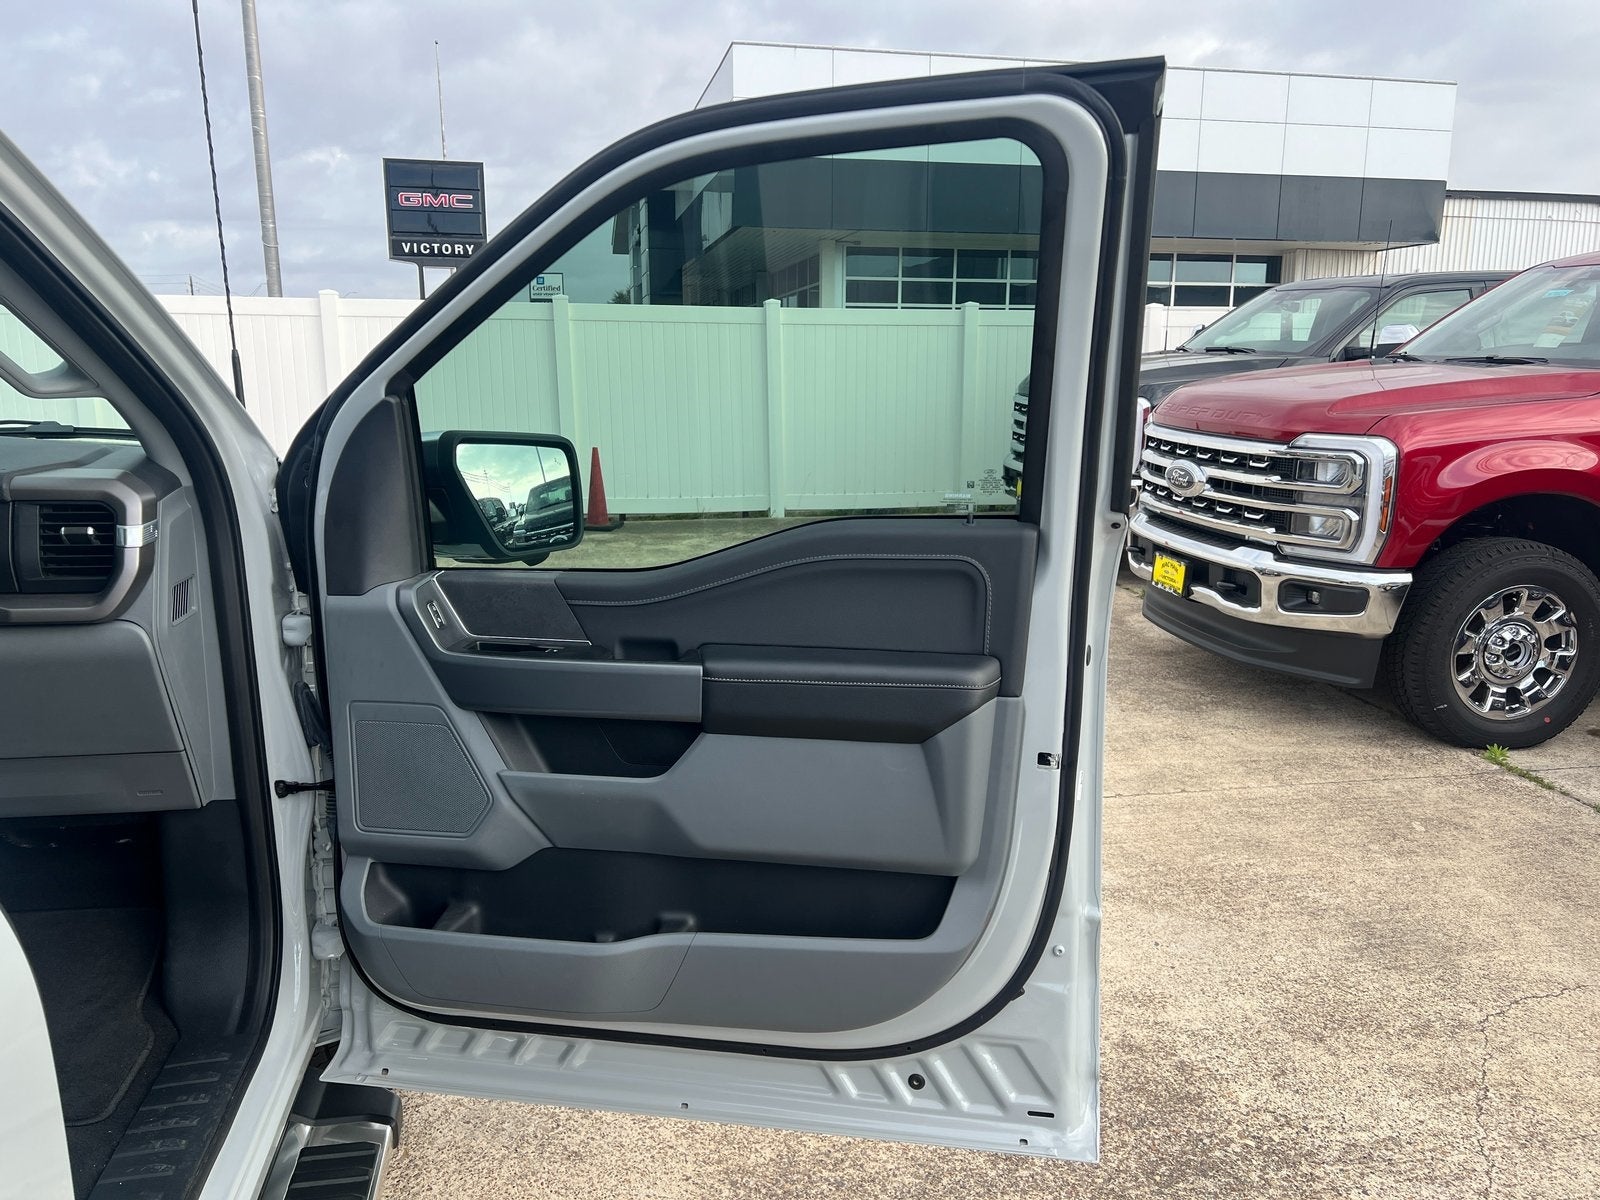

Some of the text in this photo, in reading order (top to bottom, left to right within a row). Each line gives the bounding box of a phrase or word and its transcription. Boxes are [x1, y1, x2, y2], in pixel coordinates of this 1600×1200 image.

[398, 192, 474, 208] GMC
[401, 242, 475, 255] VICTORY
[1162, 402, 1273, 424] SUPER DUTY
[1170, 468, 1189, 487] Ford
